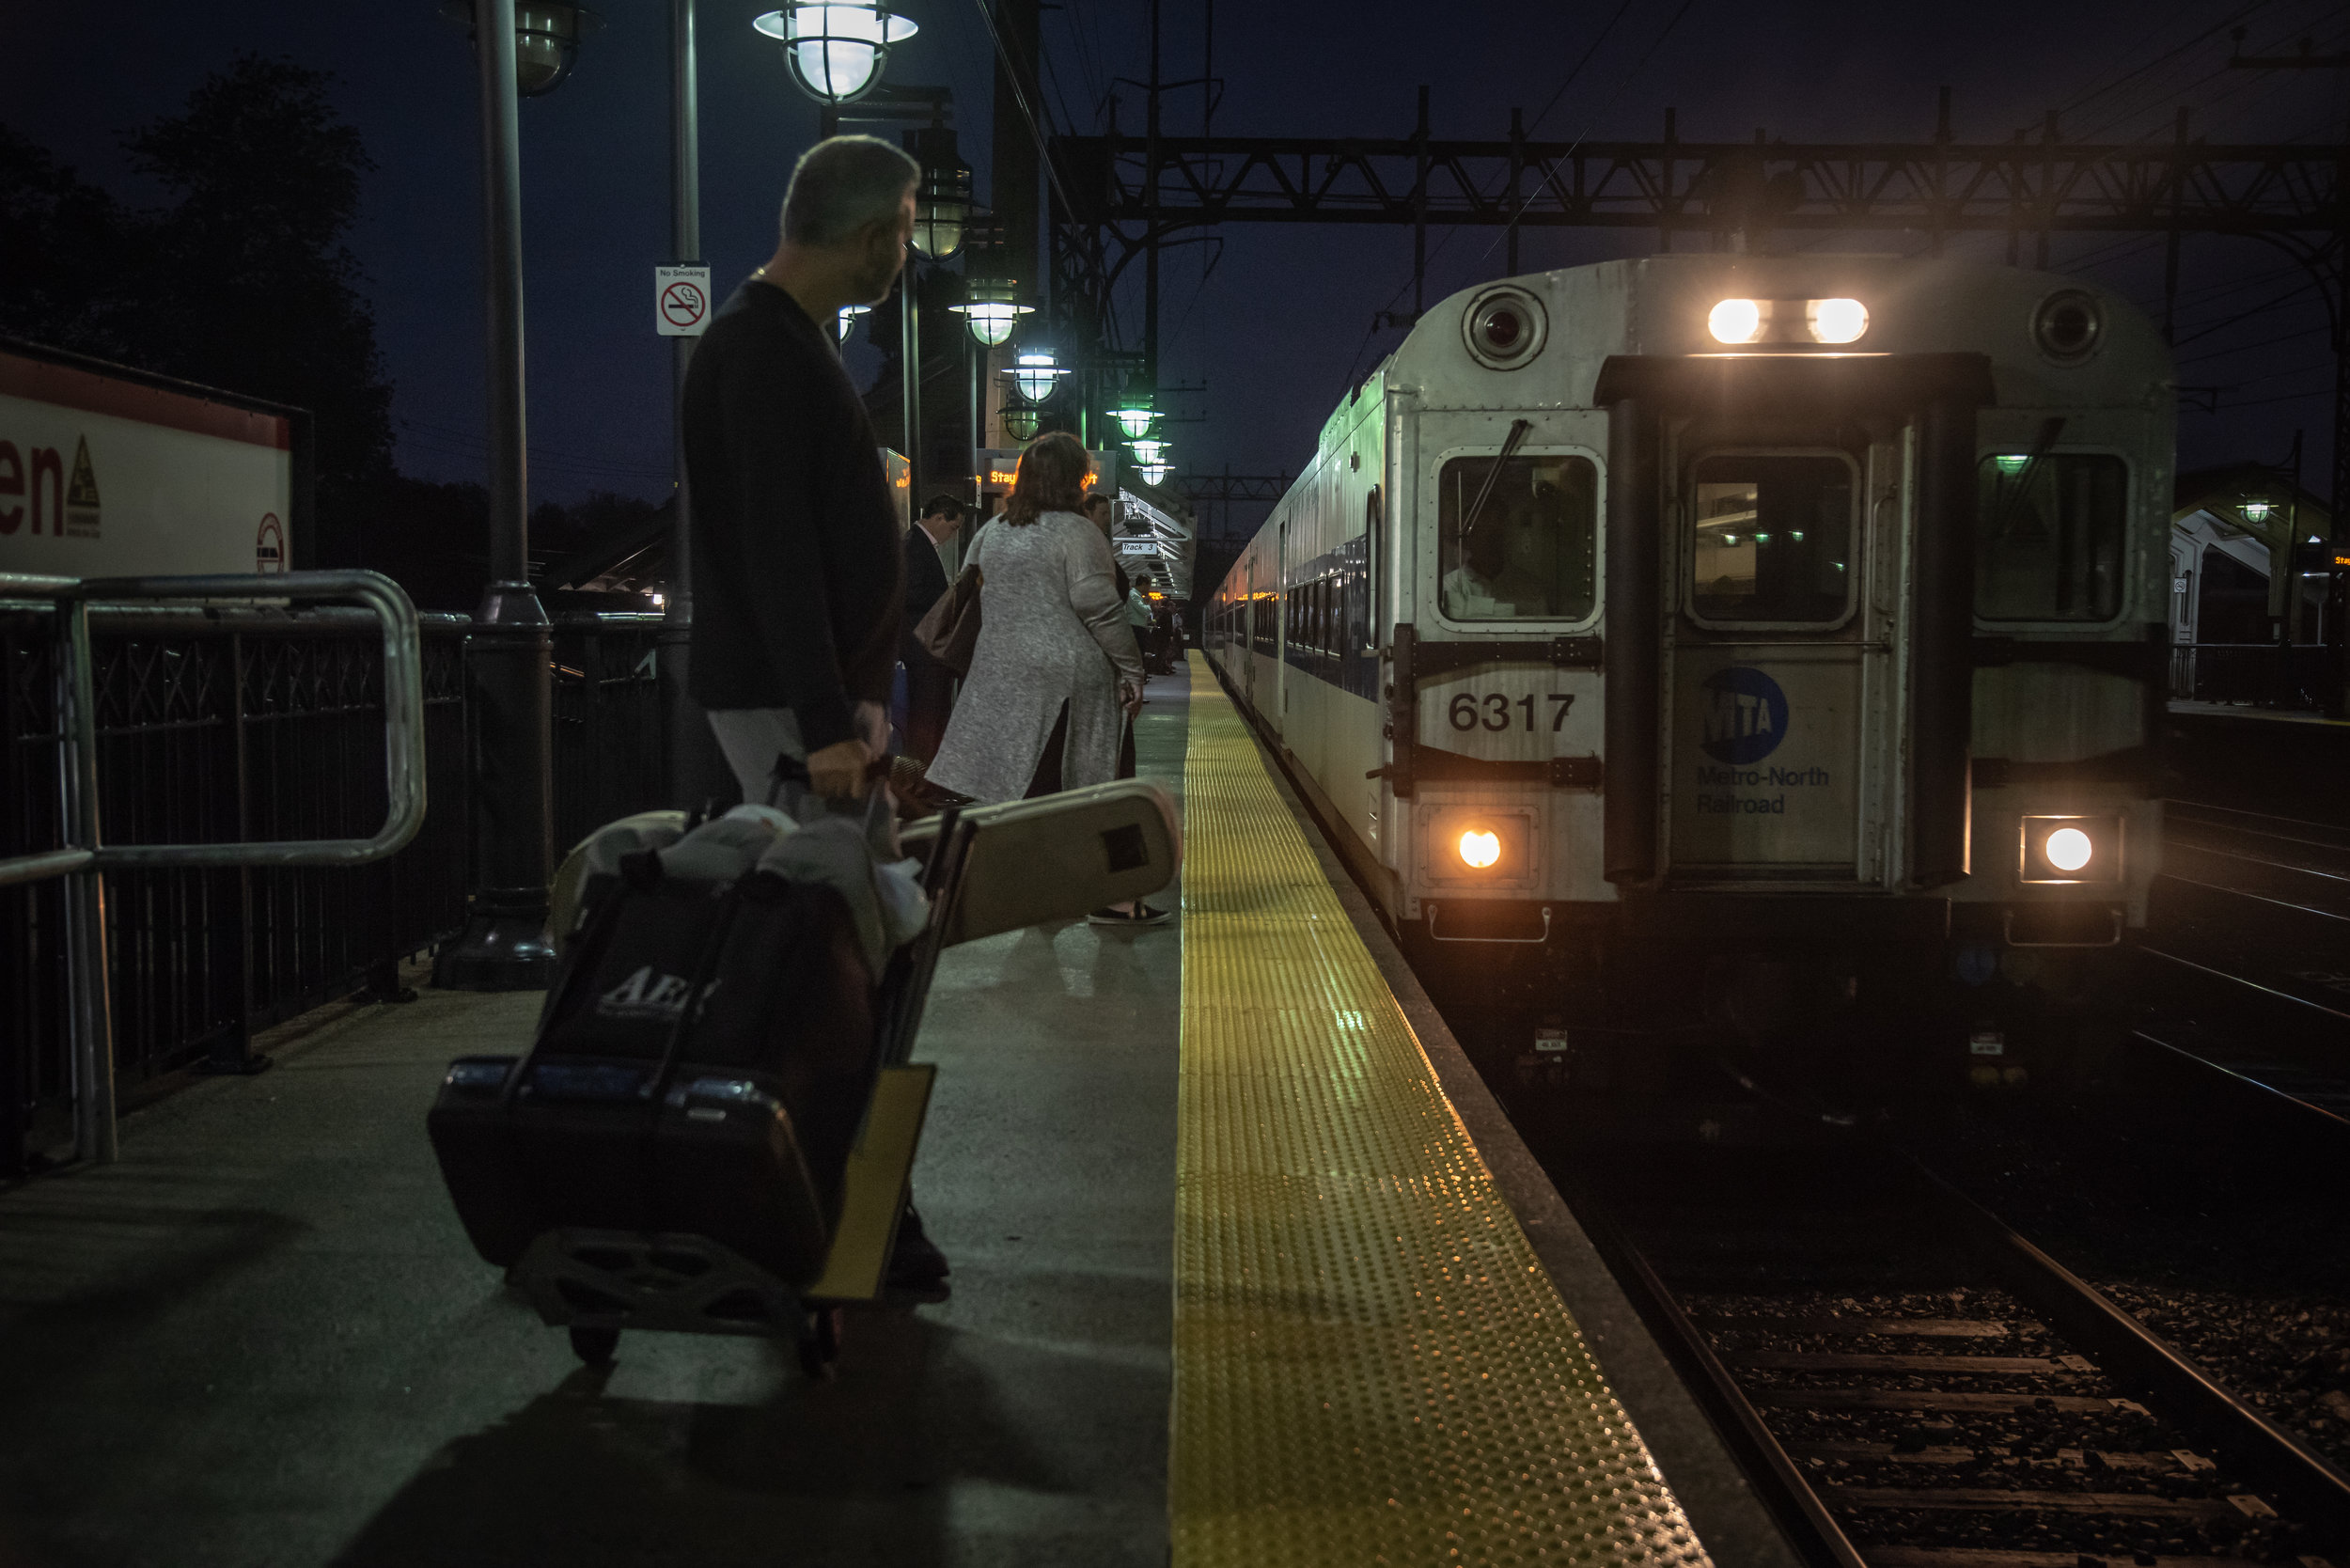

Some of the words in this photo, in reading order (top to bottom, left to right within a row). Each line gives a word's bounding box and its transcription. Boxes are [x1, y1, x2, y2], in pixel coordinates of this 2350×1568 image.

[673, 270, 705, 278] Smoking
[991, 471, 1016, 484] Stay
[1449, 693, 1574, 731] 6317
[1700, 684, 1774, 744] MTA
[1698, 766, 1829, 786] Metro-North
[1697, 794, 1784, 814] Railroad
